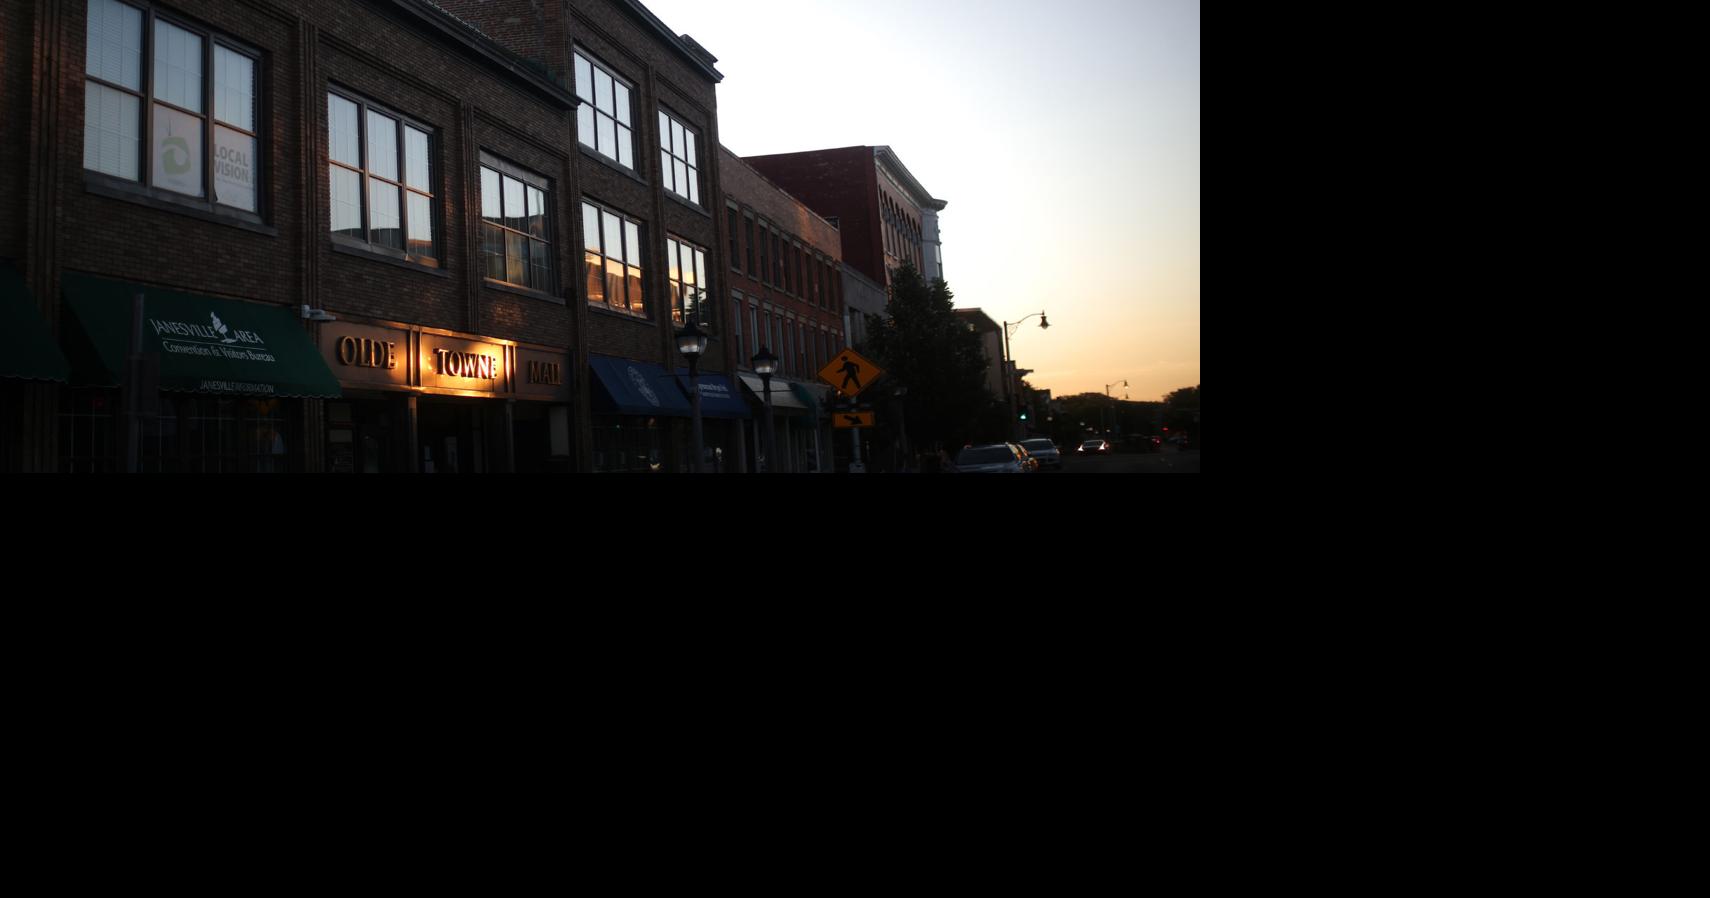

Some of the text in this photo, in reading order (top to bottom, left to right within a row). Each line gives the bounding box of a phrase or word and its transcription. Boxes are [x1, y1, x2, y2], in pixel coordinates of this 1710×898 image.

[213, 145, 249, 167] LOCAL
[213, 159, 250, 182] VISION
[149, 318, 264, 344] JANESVILLE AREA
[162, 341, 212, 356] Convention
[220, 346, 249, 361] Visitors
[246, 350, 276, 362] Bureau
[338, 335, 562, 385] OLDE TOWNE MALL
[200, 380, 234, 392] JANESVILLE
